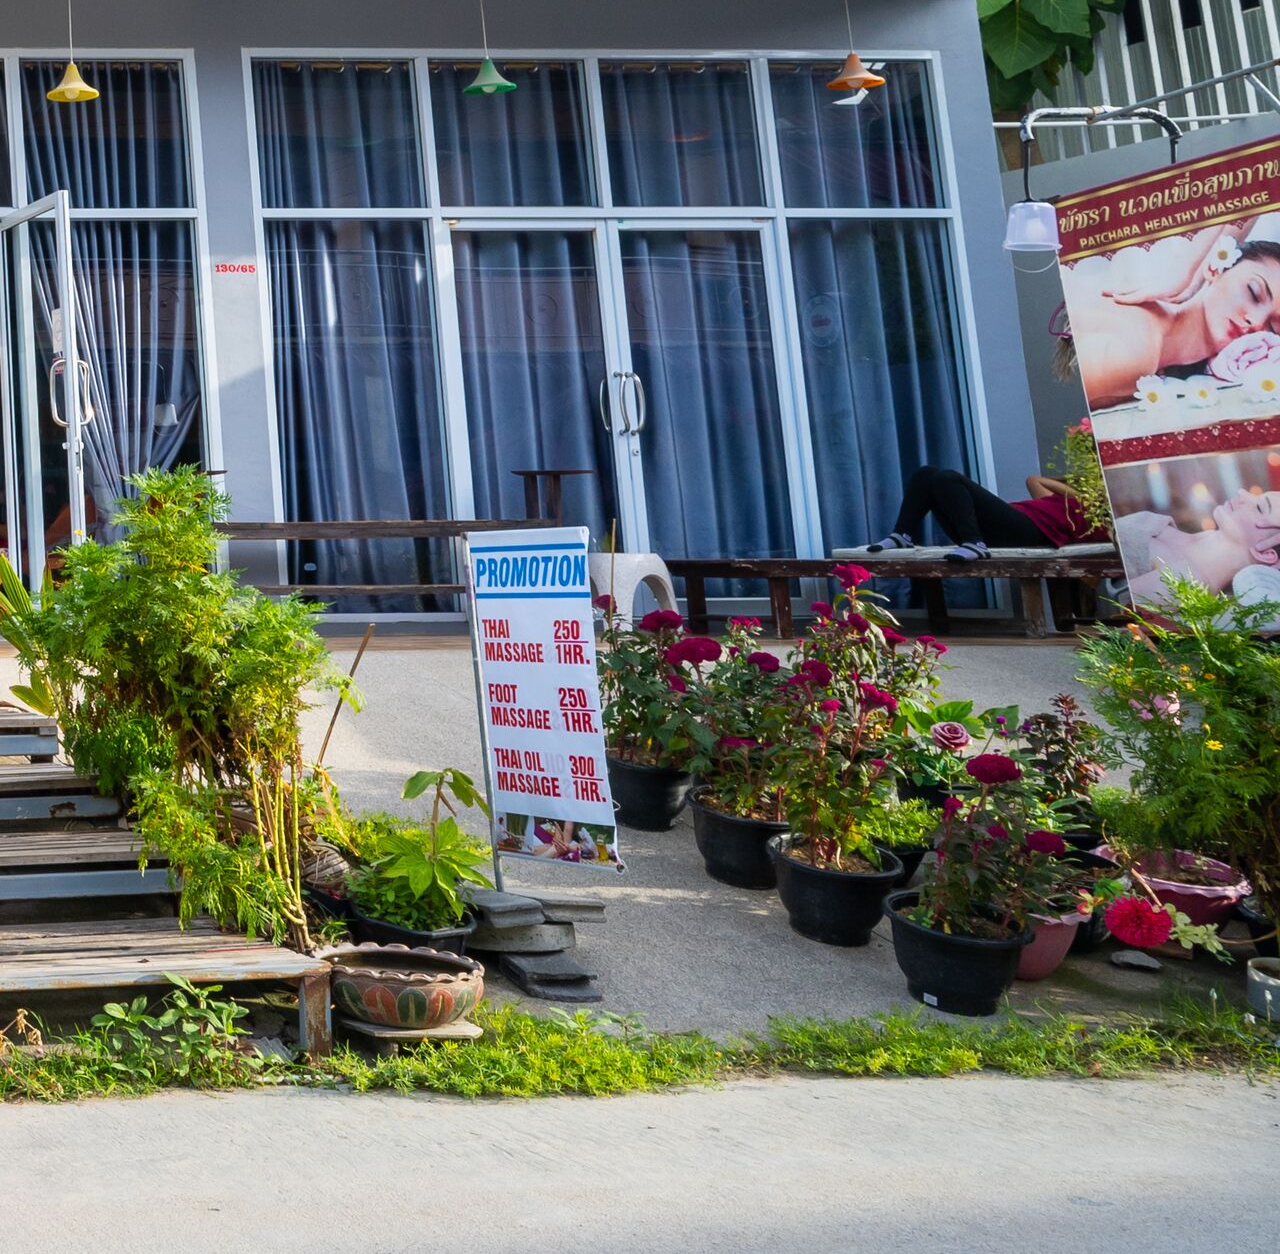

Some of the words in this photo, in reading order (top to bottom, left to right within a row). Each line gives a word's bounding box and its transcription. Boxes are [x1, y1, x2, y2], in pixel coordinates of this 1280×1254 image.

[1060, 206, 1110, 234] พัชรา
[1079, 224, 1140, 248] PATCHARA
[1145, 209, 1199, 233] HEALTHY
[1203, 191, 1270, 217] MASSAGE
[216, 264, 256, 273] 130/65
[476, 554, 586, 587] PROMOTION
[482, 619, 510, 639] THAI
[553, 619, 580, 640] 250
[485, 642, 544, 663] MASSAGE
[556, 644, 590, 665] 1HR.
[488, 683, 517, 704] FOOT
[558, 688, 587, 708] 250
[491, 706, 551, 730] MASSAGE
[562, 711, 598, 733] 1HR.
[494, 748, 522, 770] THAI
[525, 751, 544, 772] OIL
[570, 755, 595, 777] 300
[497, 771, 561, 797] MASSAGE
[572, 779, 607, 803] 1HR.
